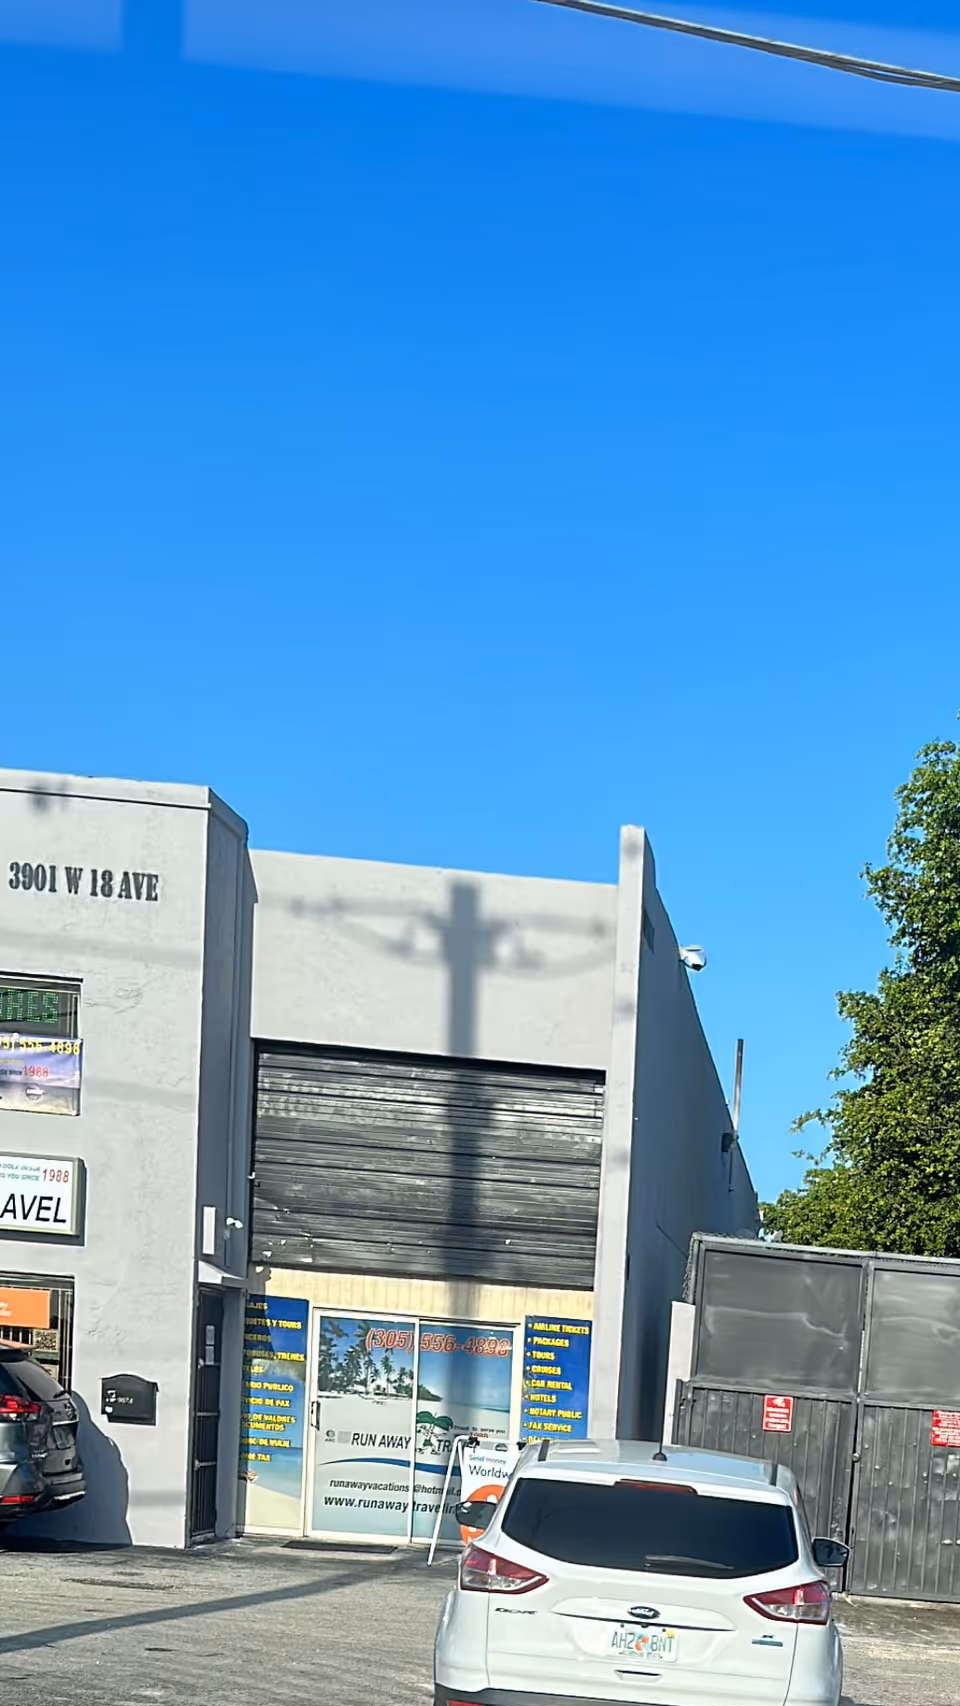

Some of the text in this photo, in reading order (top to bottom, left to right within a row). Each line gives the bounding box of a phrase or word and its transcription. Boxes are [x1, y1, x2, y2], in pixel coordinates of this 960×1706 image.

[9, 861, 159, 902] 3901 W 18 AVE
[23, 1065, 49, 1077] 1988
[42, 1168, 69, 1183] 1988
[0, 1192, 67, 1223] AVEL
[278, 1320, 302, 1330] TOURS
[562, 1324, 590, 1335] TICKETS
[365, 1328, 415, 1353] (305)
[533, 1336, 569, 1348] PACKAGES
[532, 1350, 555, 1361] TOURS
[531, 1365, 561, 1376] CRUISES
[263, 1382, 294, 1393] PUBLICO
[531, 1379, 572, 1390] CAR RENTAL
[530, 1393, 556, 1403] HOTELS
[529, 1407, 582, 1418] NOTARY PUBLIC
[528, 1421, 572, 1433] FAX SERVICE
[351, 1432, 377, 1448] RUN
[378, 1434, 411, 1449] AWAY
[469, 1464, 511, 1479] Worldw
